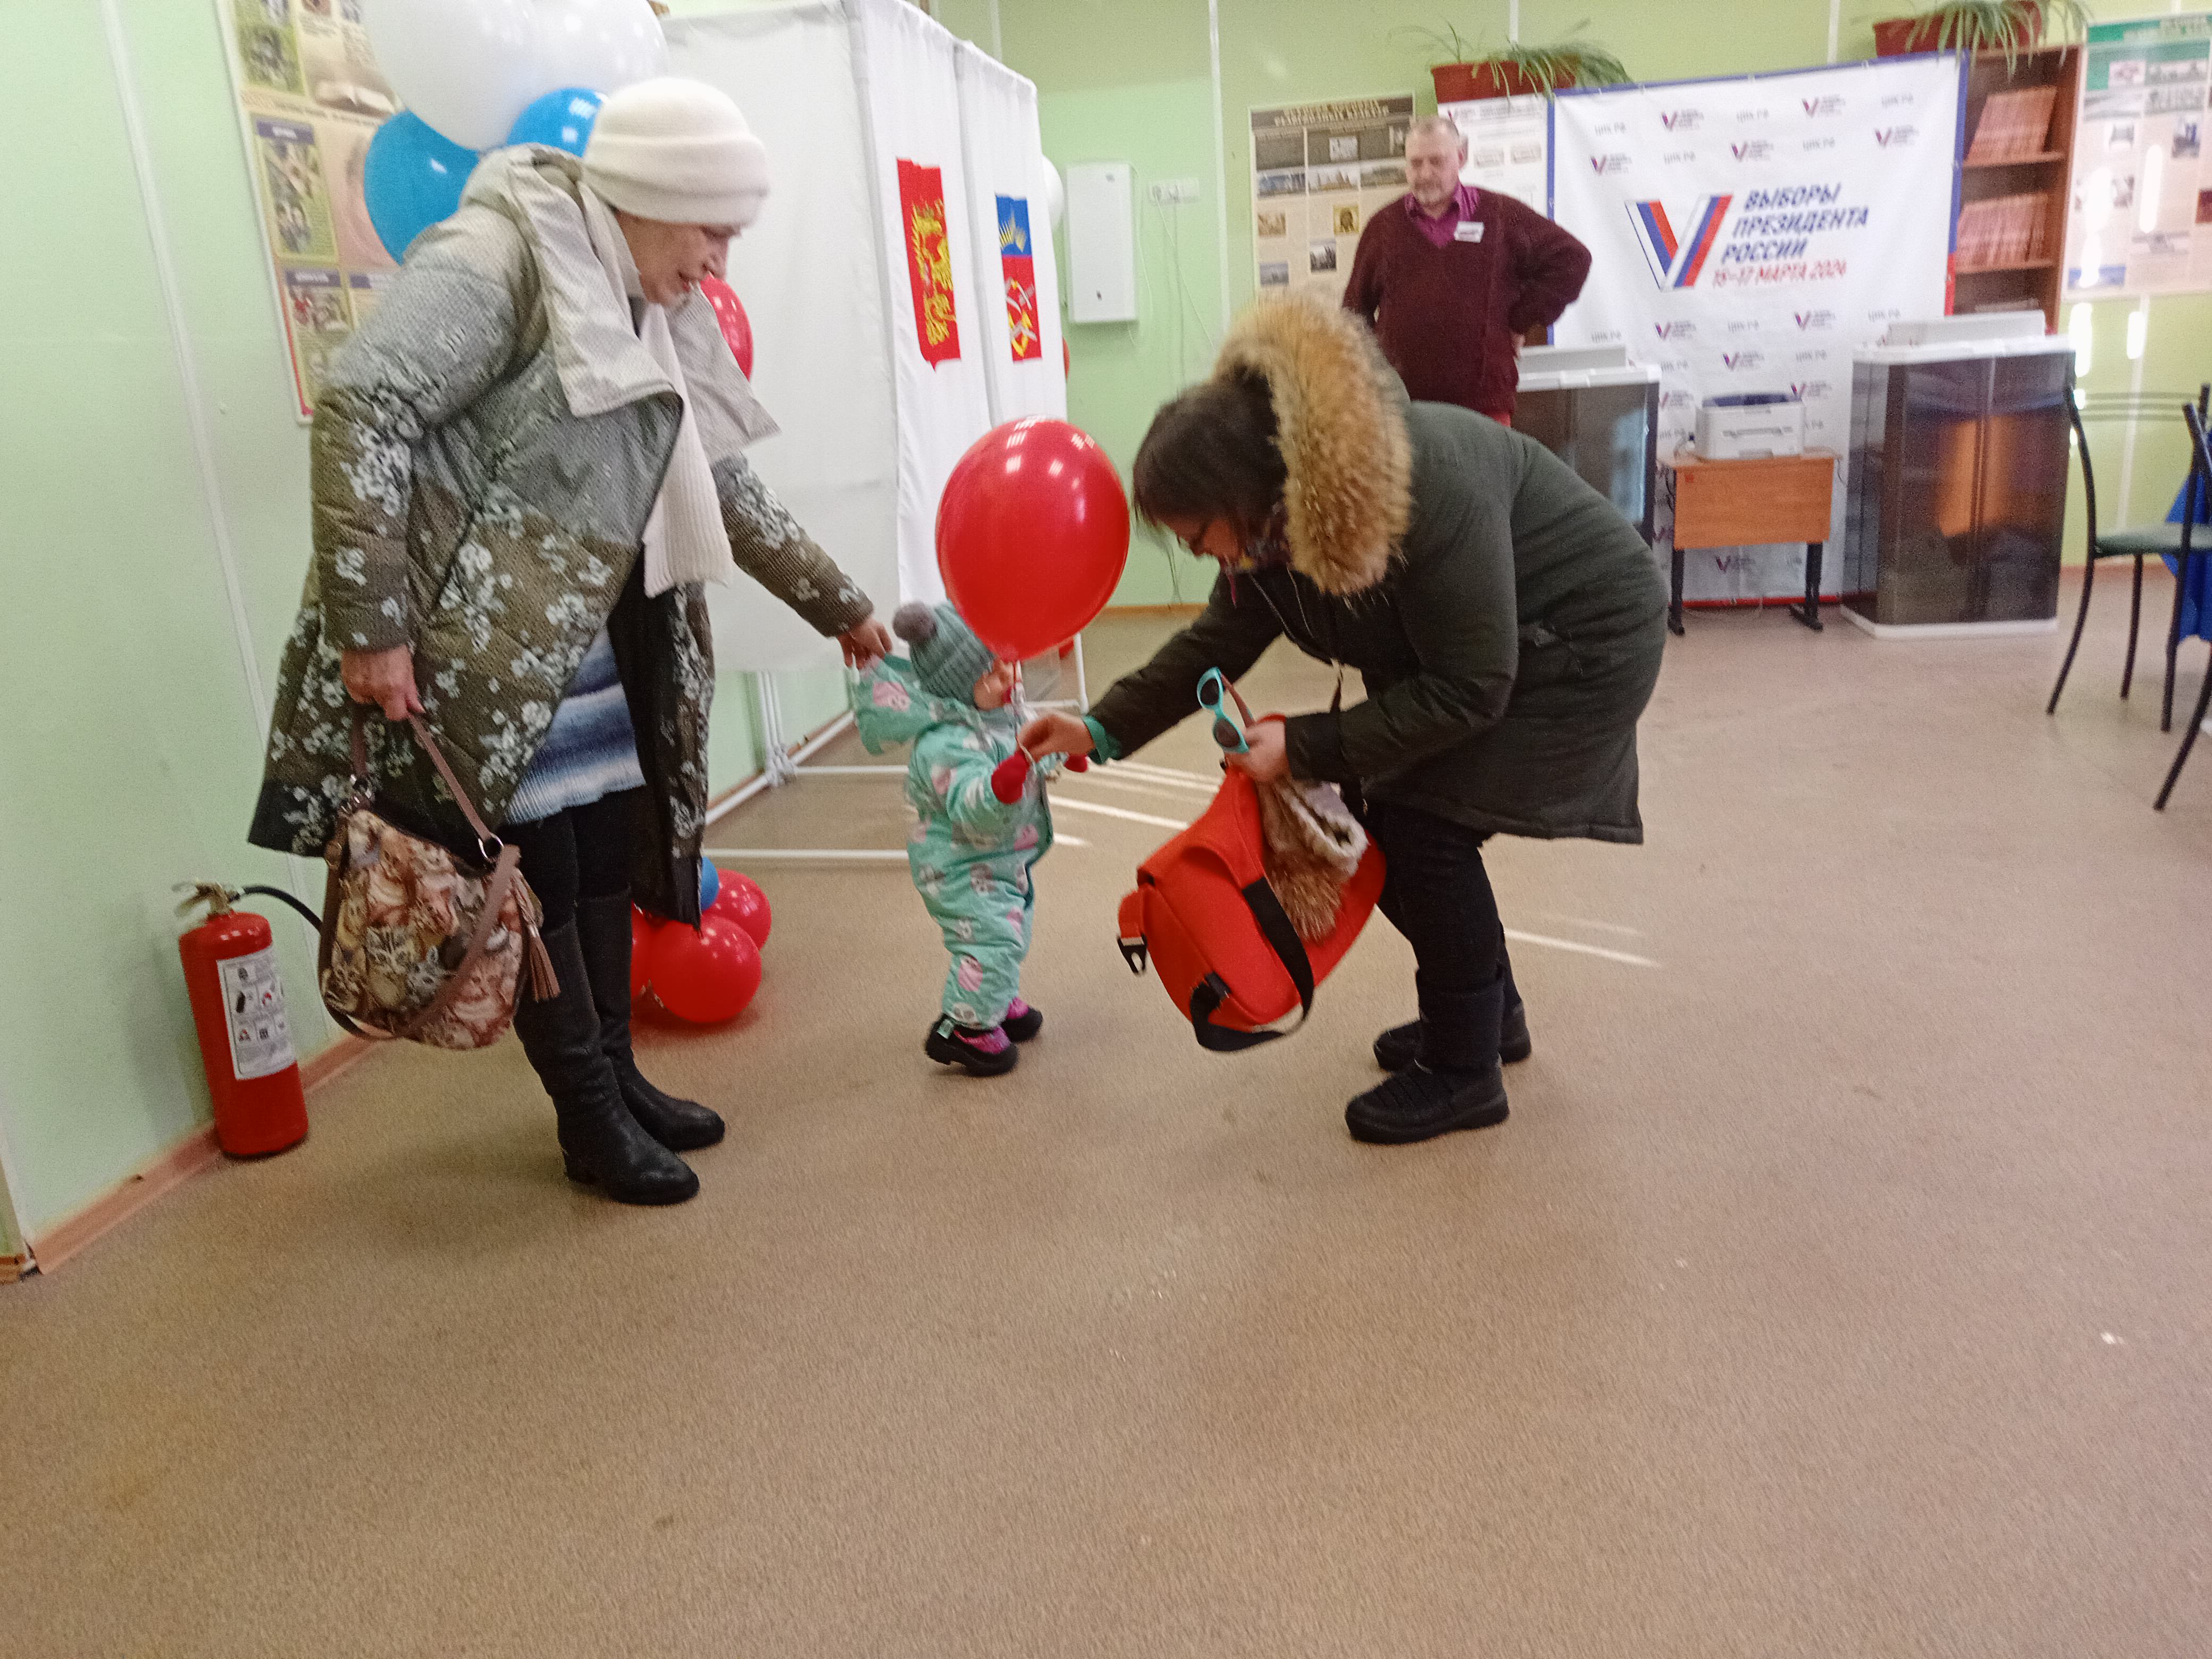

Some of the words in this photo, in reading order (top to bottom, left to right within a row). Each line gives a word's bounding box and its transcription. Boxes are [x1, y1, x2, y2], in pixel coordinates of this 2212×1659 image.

[1745, 182, 1841, 211] ВЫБОРЫ
[1732, 207, 1869, 239] ПРЕЗИДЕНТА
[1721, 239, 1807, 264] РОССИИ
